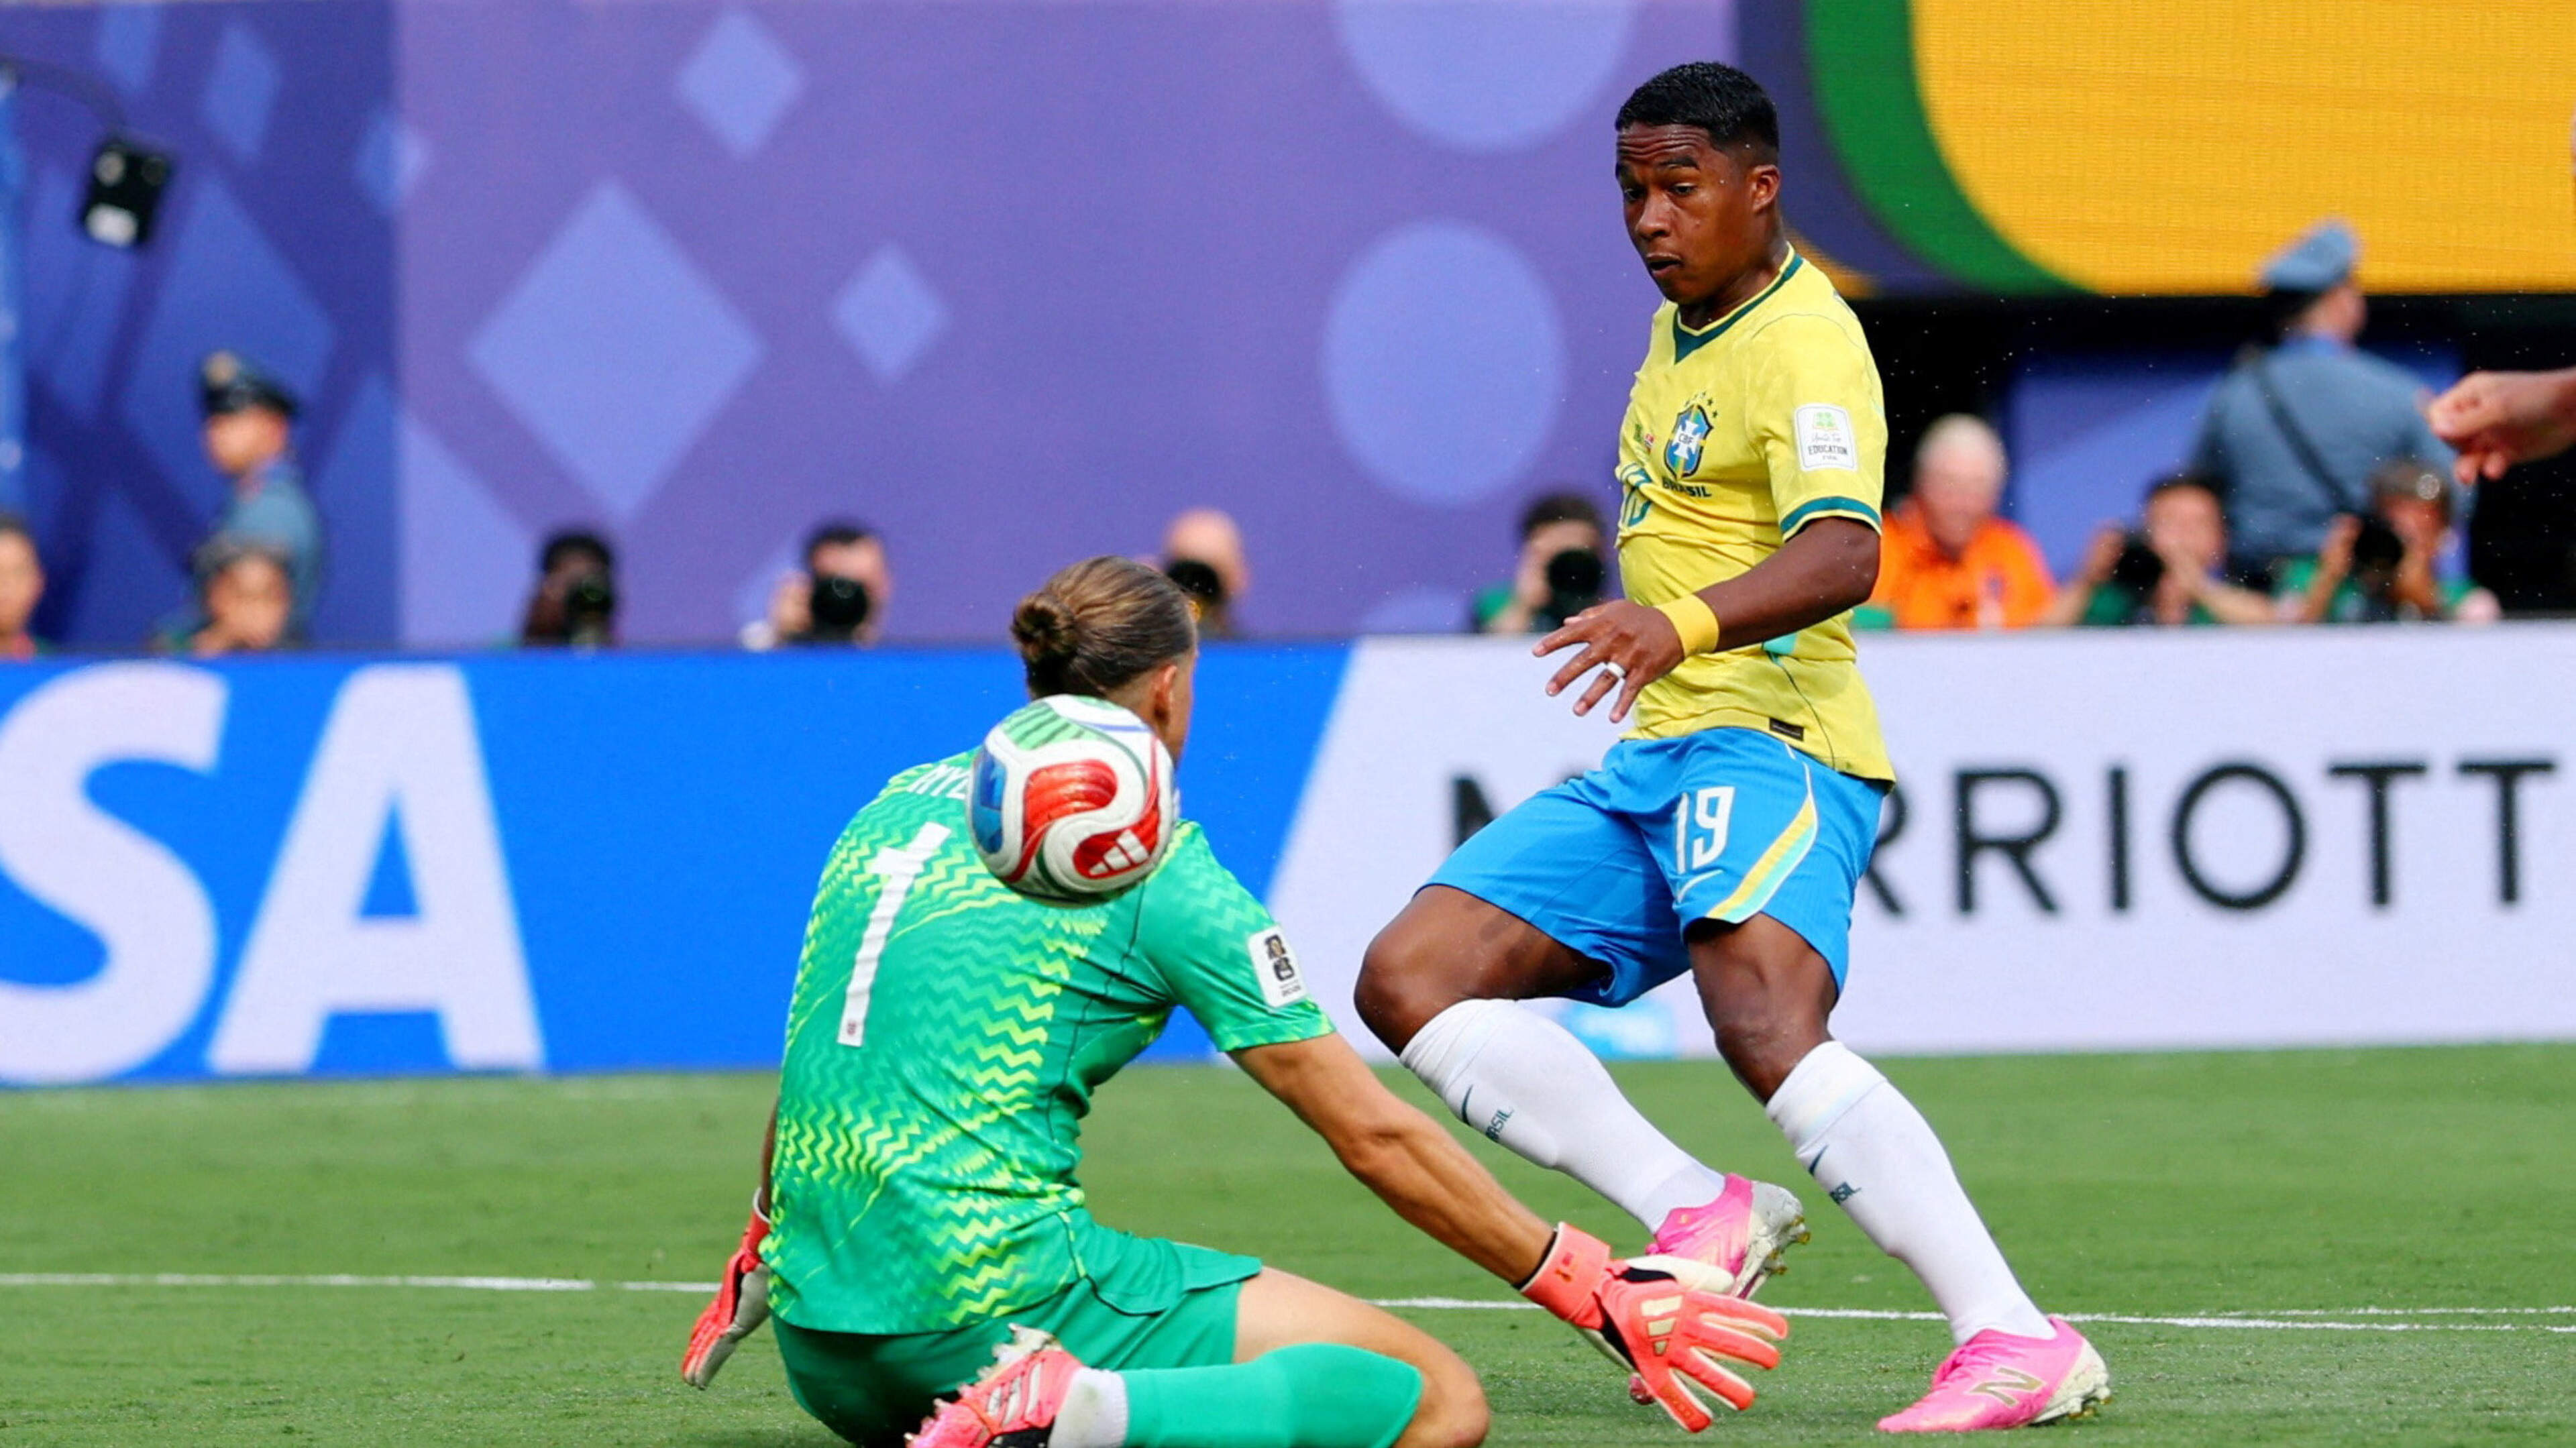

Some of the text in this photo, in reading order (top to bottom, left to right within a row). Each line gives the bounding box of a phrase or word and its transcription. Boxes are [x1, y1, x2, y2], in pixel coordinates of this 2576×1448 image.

[1661, 475, 1712, 497] BRASIL
[1808, 445, 1847, 455] EDUCATION
[0, 658, 546, 1085] SA
[1451, 760, 2556, 913] RIOTT
[1675, 786, 1735, 875] 19
[837, 821, 952, 1047] 1
[1484, 1109, 1514, 1142] ASIL
